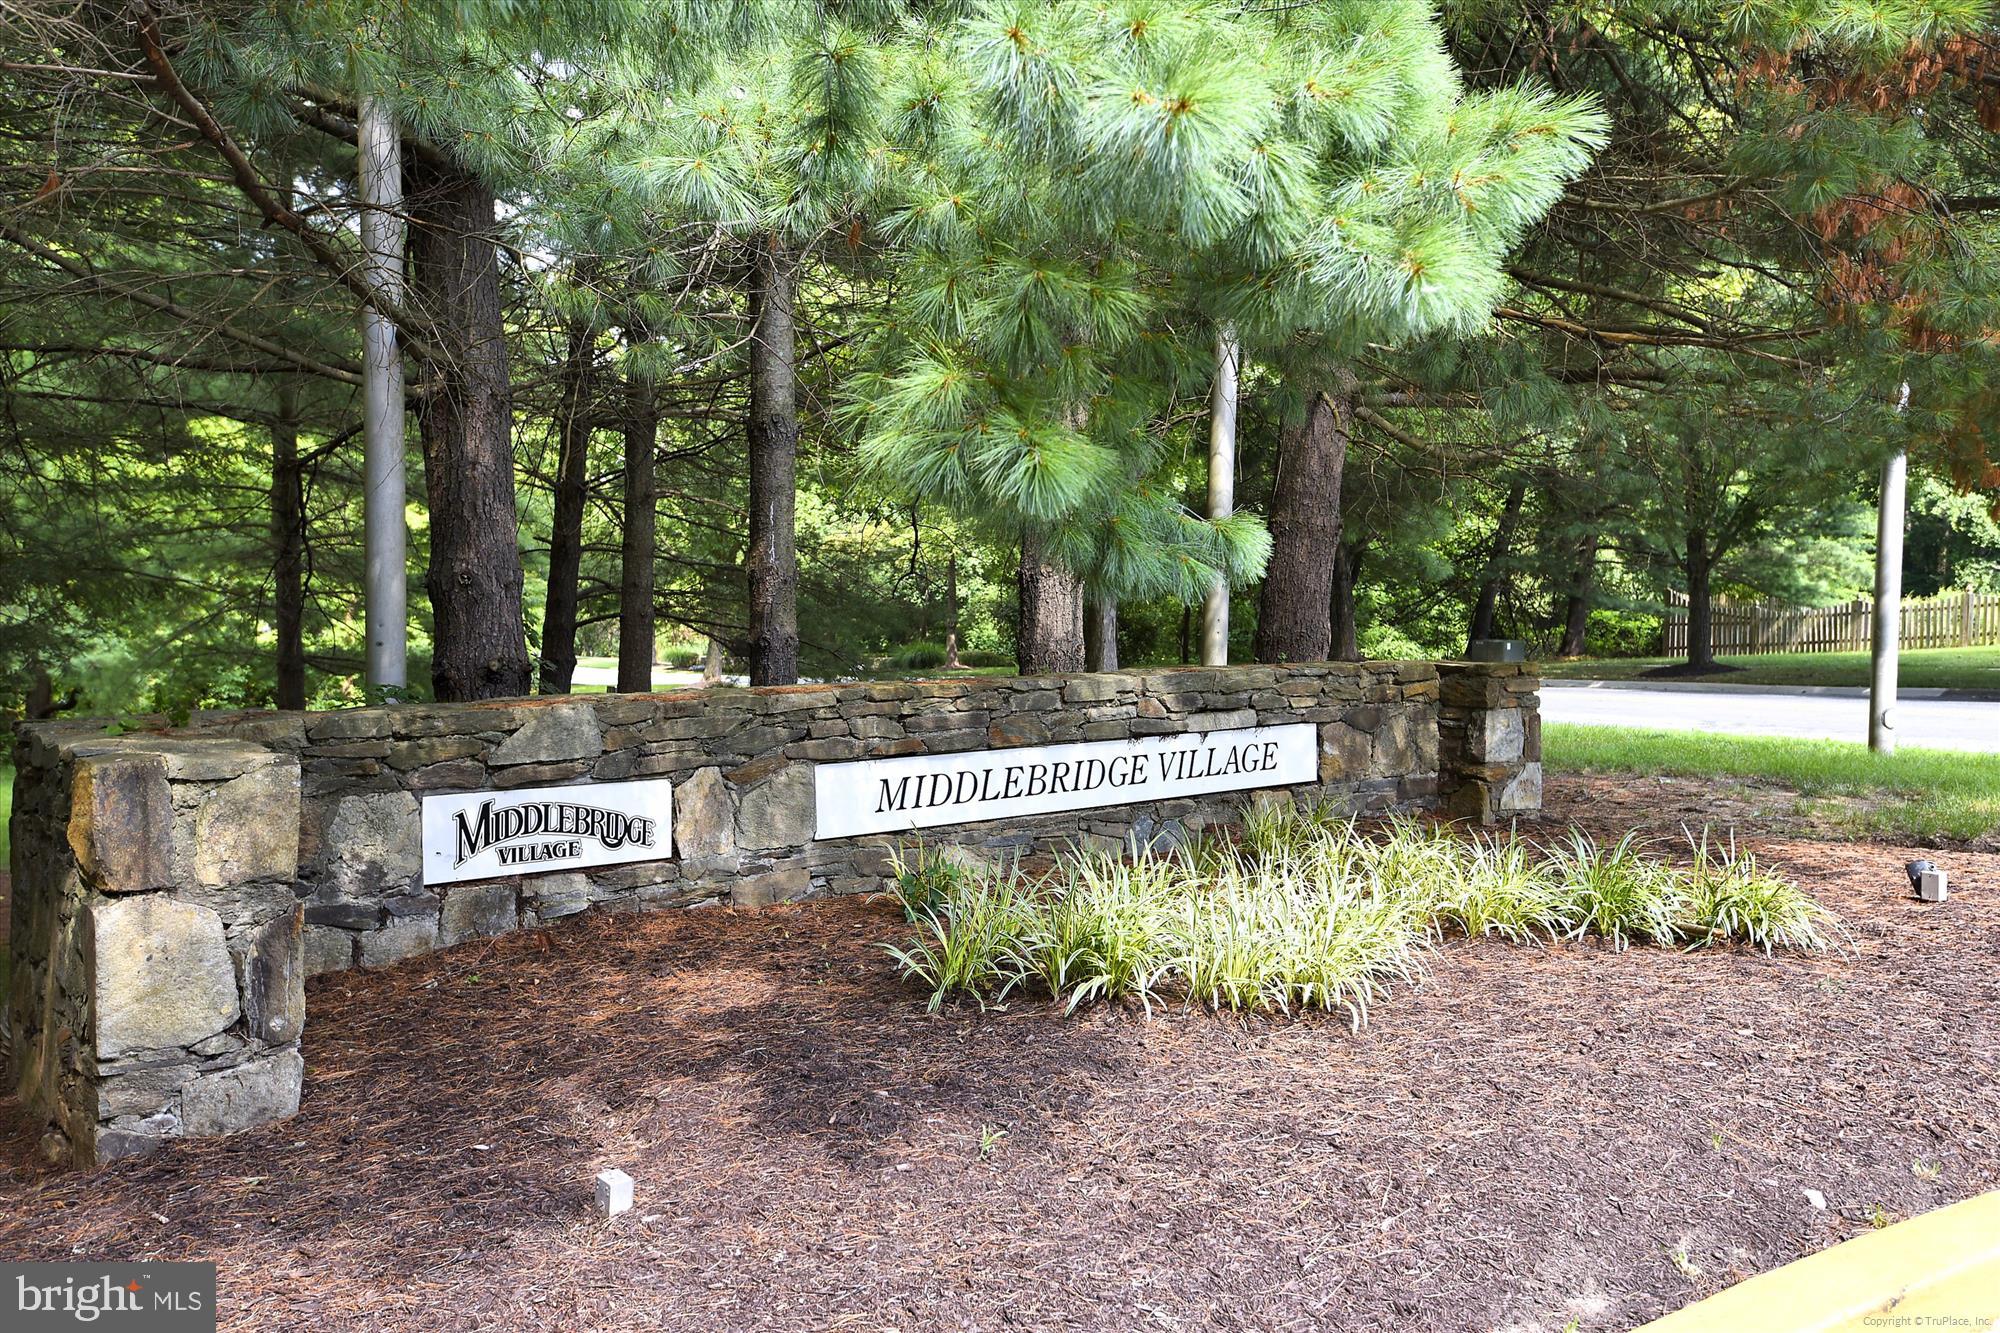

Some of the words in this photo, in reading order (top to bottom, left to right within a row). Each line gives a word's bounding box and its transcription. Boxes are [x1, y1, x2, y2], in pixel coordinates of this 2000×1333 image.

[875, 754, 1149, 813] MIDDLEBRIDGE
[1157, 742, 1279, 782] VILLAGE
[453, 798, 656, 870] MIDDLEBRIDGE
[496, 839, 583, 866] VILLAGE
